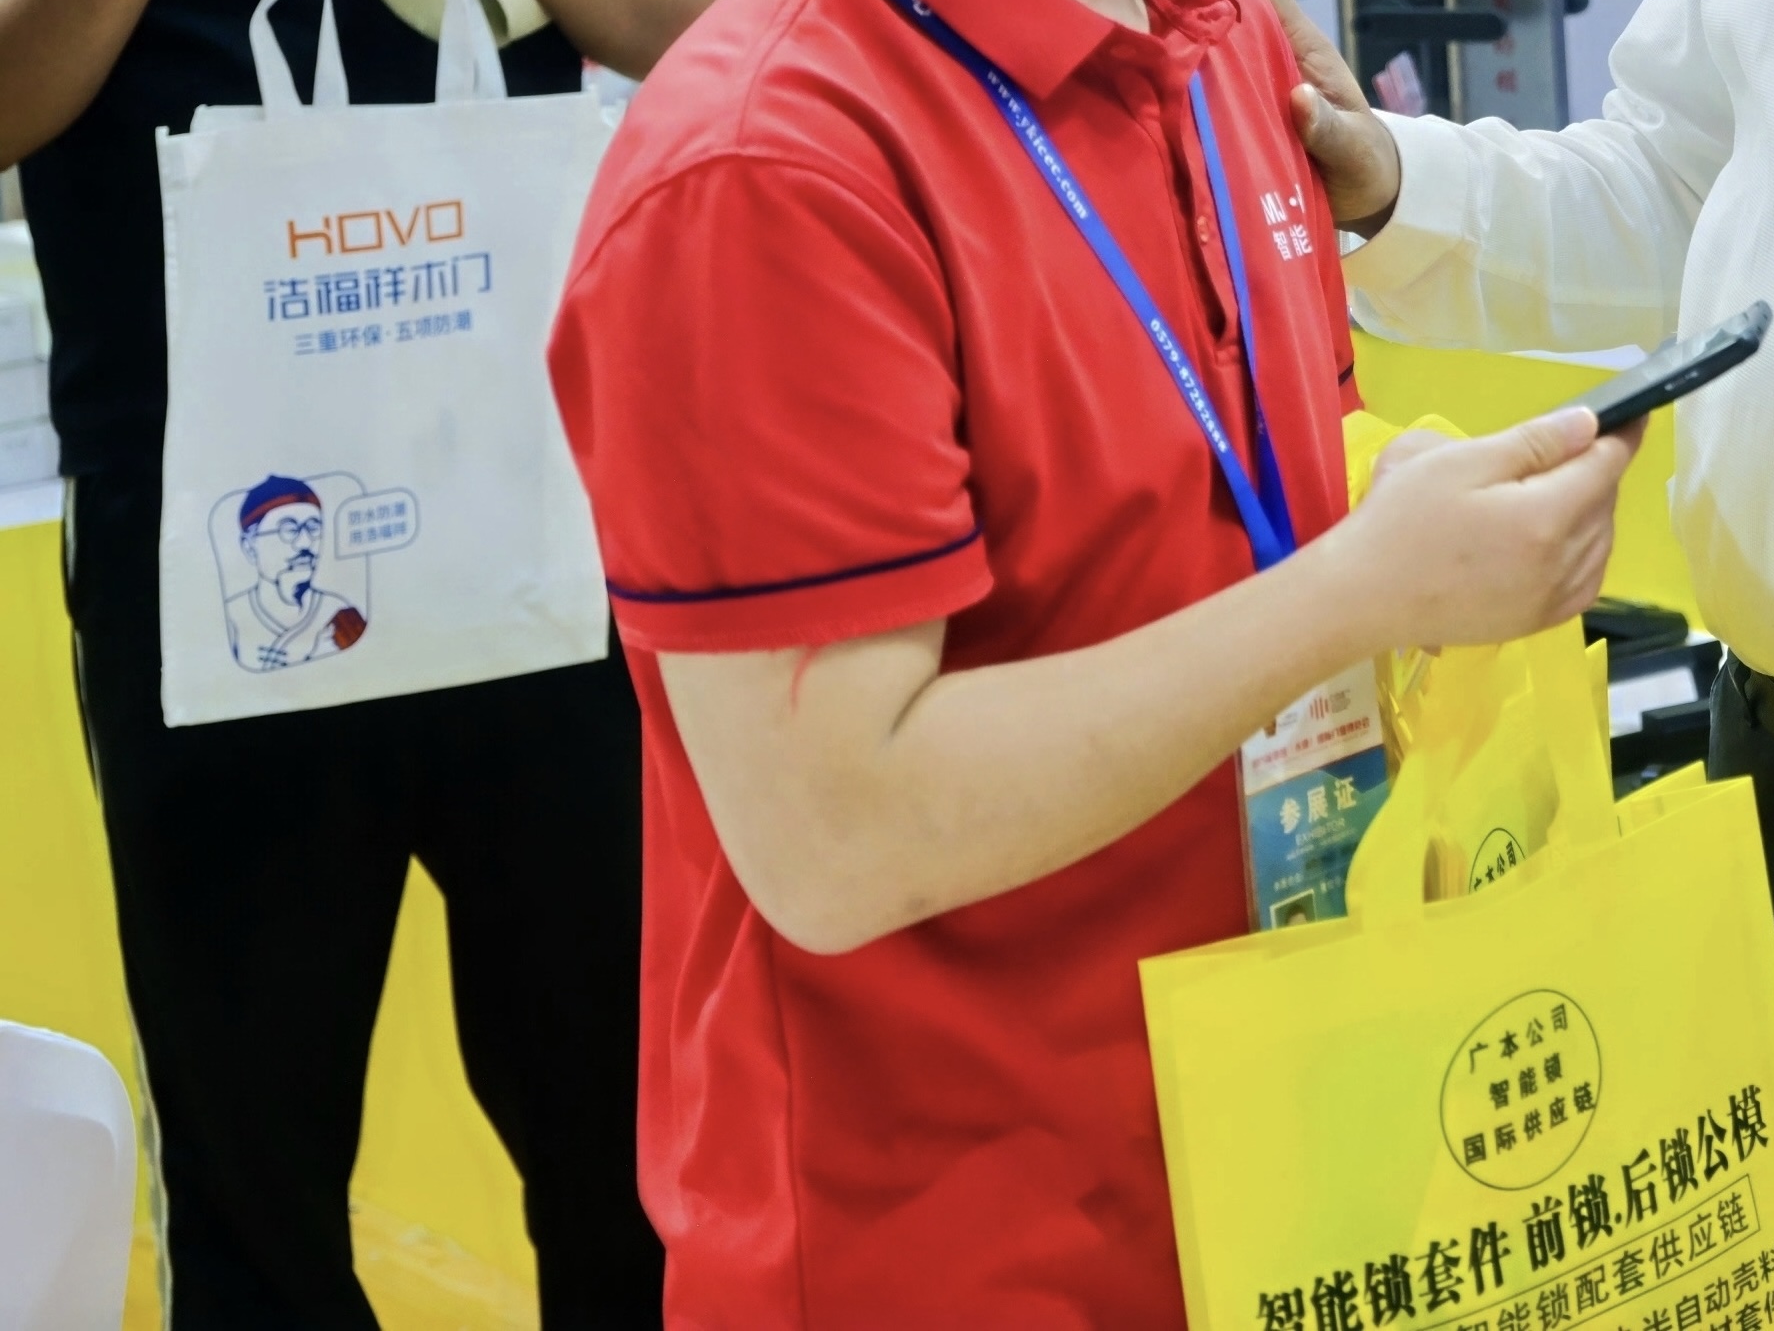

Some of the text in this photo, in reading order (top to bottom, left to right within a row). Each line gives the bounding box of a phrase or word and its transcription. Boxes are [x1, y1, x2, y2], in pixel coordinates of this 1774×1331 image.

[286, 199, 465, 260] HOVO
[1279, 775, 1358, 835] 参展证
[1468, 1003, 1569, 1075] 广本公司
[1489, 1052, 1563, 1111] 智能锁
[1462, 1081, 1596, 1168] 国际供应链
